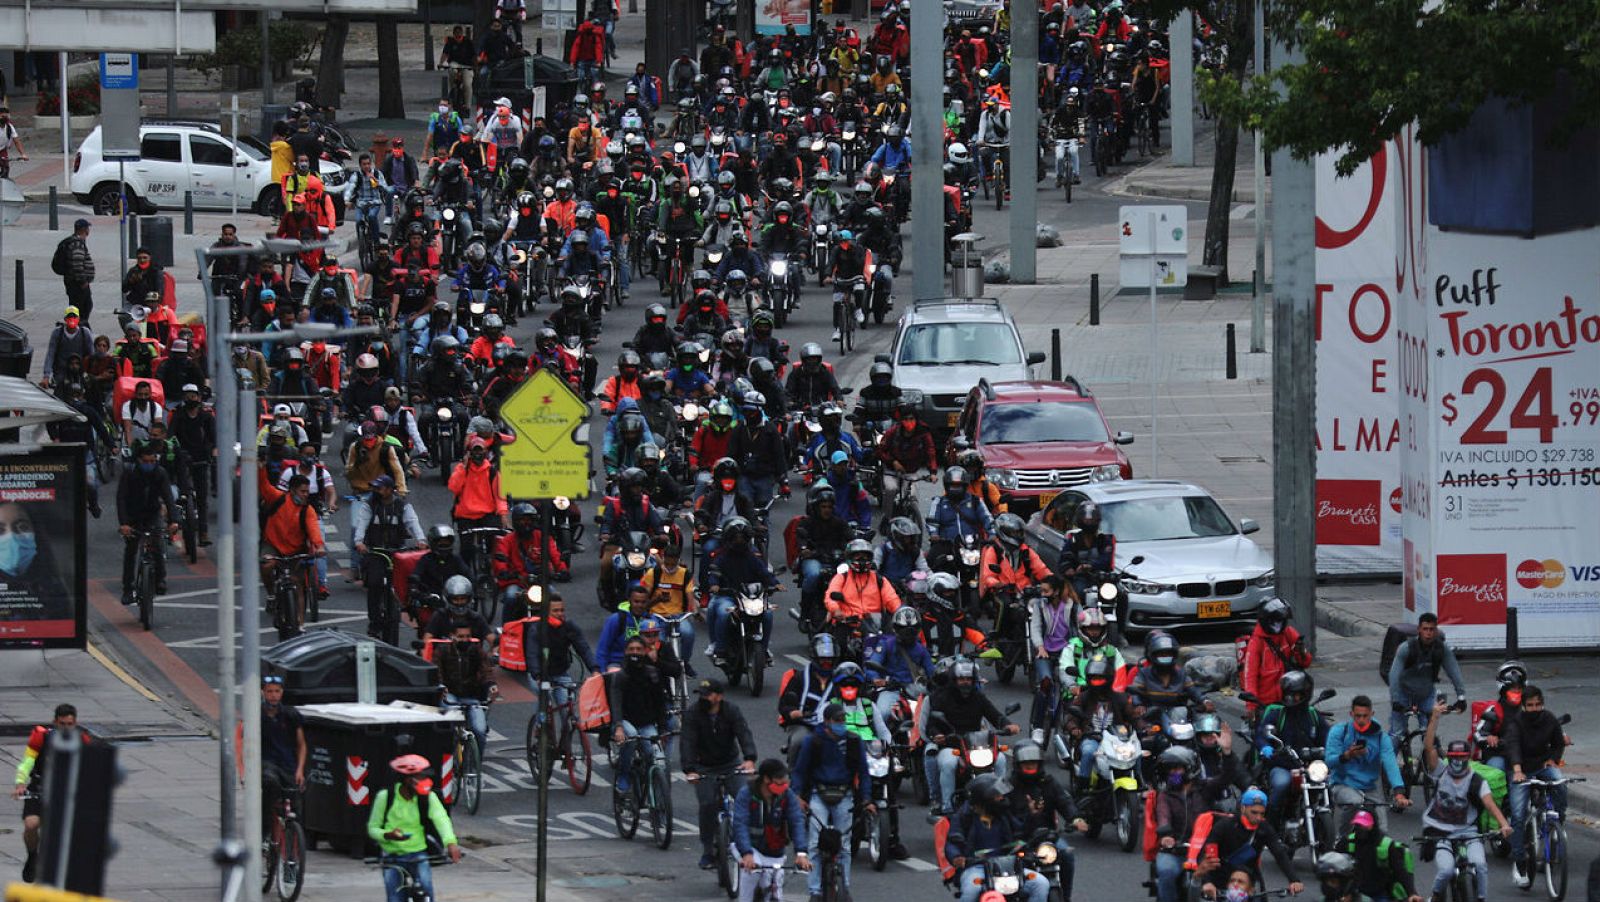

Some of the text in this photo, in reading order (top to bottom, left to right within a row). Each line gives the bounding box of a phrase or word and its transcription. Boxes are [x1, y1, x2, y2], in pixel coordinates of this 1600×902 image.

[1435, 268, 1501, 306] Puff
[1439, 295, 1600, 356] Toronto
[1440, 449, 1595, 463] IVA INCLUIDO $29.738
[4, 473, 55, 481] APRENDIENDO
[1441, 467, 1600, 489] Antes $ 130.150
[1318, 501, 1377, 518] Brunati
[1445, 495, 1463, 512] 31
[1351, 512, 1377, 524] CASA
[1517, 571, 1565, 579] MasterCard
[1440, 578, 1503, 597] Brunati
[1533, 591, 1554, 599] PAGO
[1475, 591, 1504, 602] CASA
